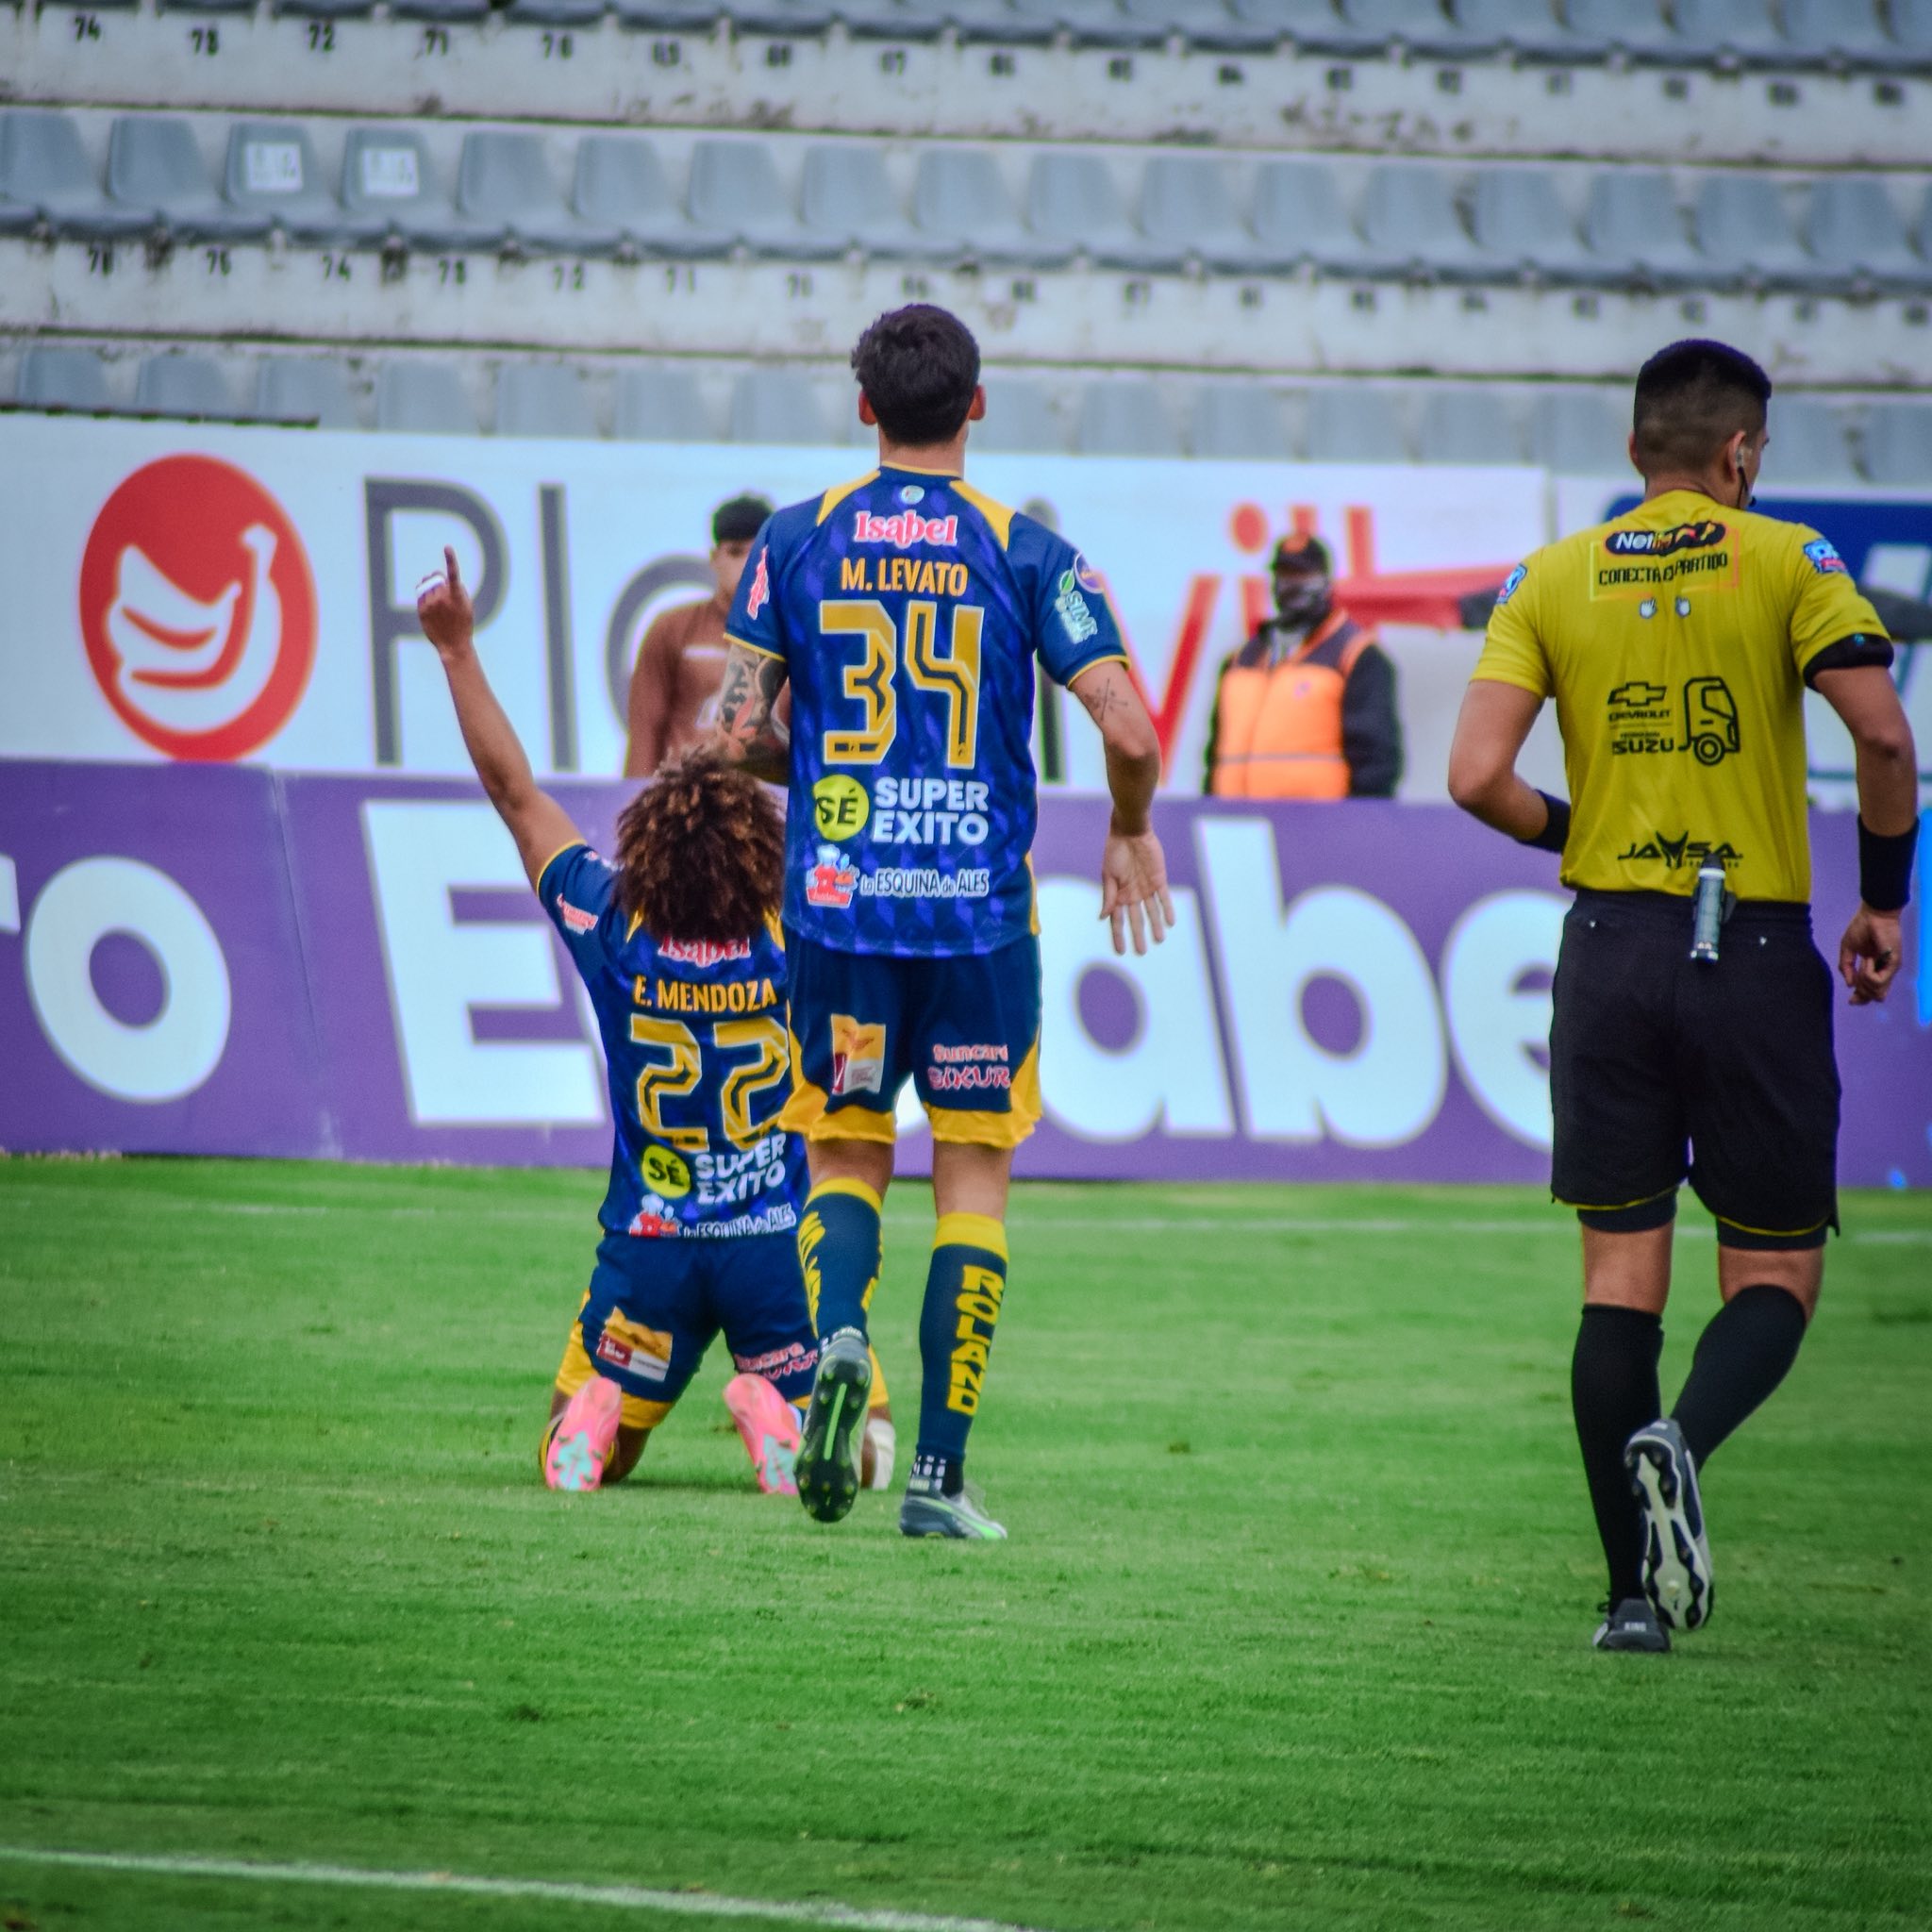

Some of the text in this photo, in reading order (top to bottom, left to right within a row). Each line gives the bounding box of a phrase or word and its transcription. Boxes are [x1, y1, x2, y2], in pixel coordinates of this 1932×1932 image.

[853, 509, 958, 549] Isabel
[841, 558, 969, 596] M. LEVATO
[820, 599, 985, 770] 34
[874, 775, 990, 811] SUPER
[872, 811, 990, 845] EXITO
[876, 870, 940, 896] ESQUINA
[958, 870, 990, 896] ALES
[634, 974, 778, 1012] E. MENDOZA
[630, 1012, 791, 1153] 22
[697, 1159, 786, 1205] EXITO
[947, 1264, 1006, 1416] ROLAND
